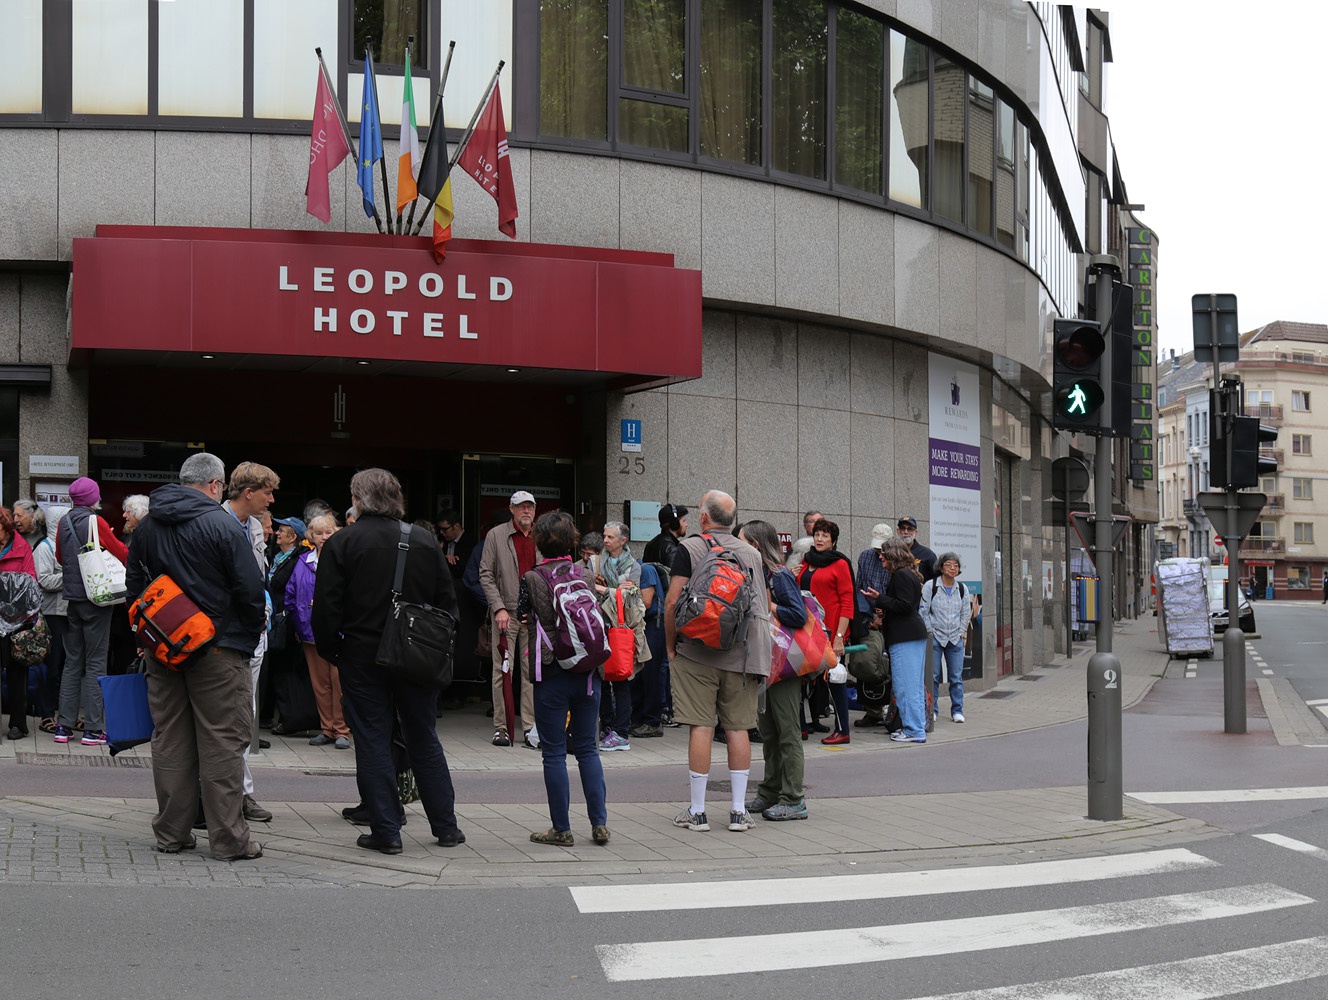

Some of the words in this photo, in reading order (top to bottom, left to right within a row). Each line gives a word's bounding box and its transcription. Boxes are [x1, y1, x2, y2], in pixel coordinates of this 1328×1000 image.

[279, 265, 514, 302] LEOPOLD
[1137, 229, 1151, 365] CARLTON
[313, 307, 479, 339] HOTEL
[945, 406, 969, 419] REWARDS
[627, 423, 636, 438] H
[1139, 384, 1152, 479] FLATS
[619, 456, 646, 475] 25
[931, 448, 949, 462] MAKE
[950, 451, 965, 464] YOUR
[965, 454, 979, 467] STAYS
[931, 465, 949, 478] MORE
[950, 468, 979, 482] REWARDING
[1103, 669, 1118, 689] 2
